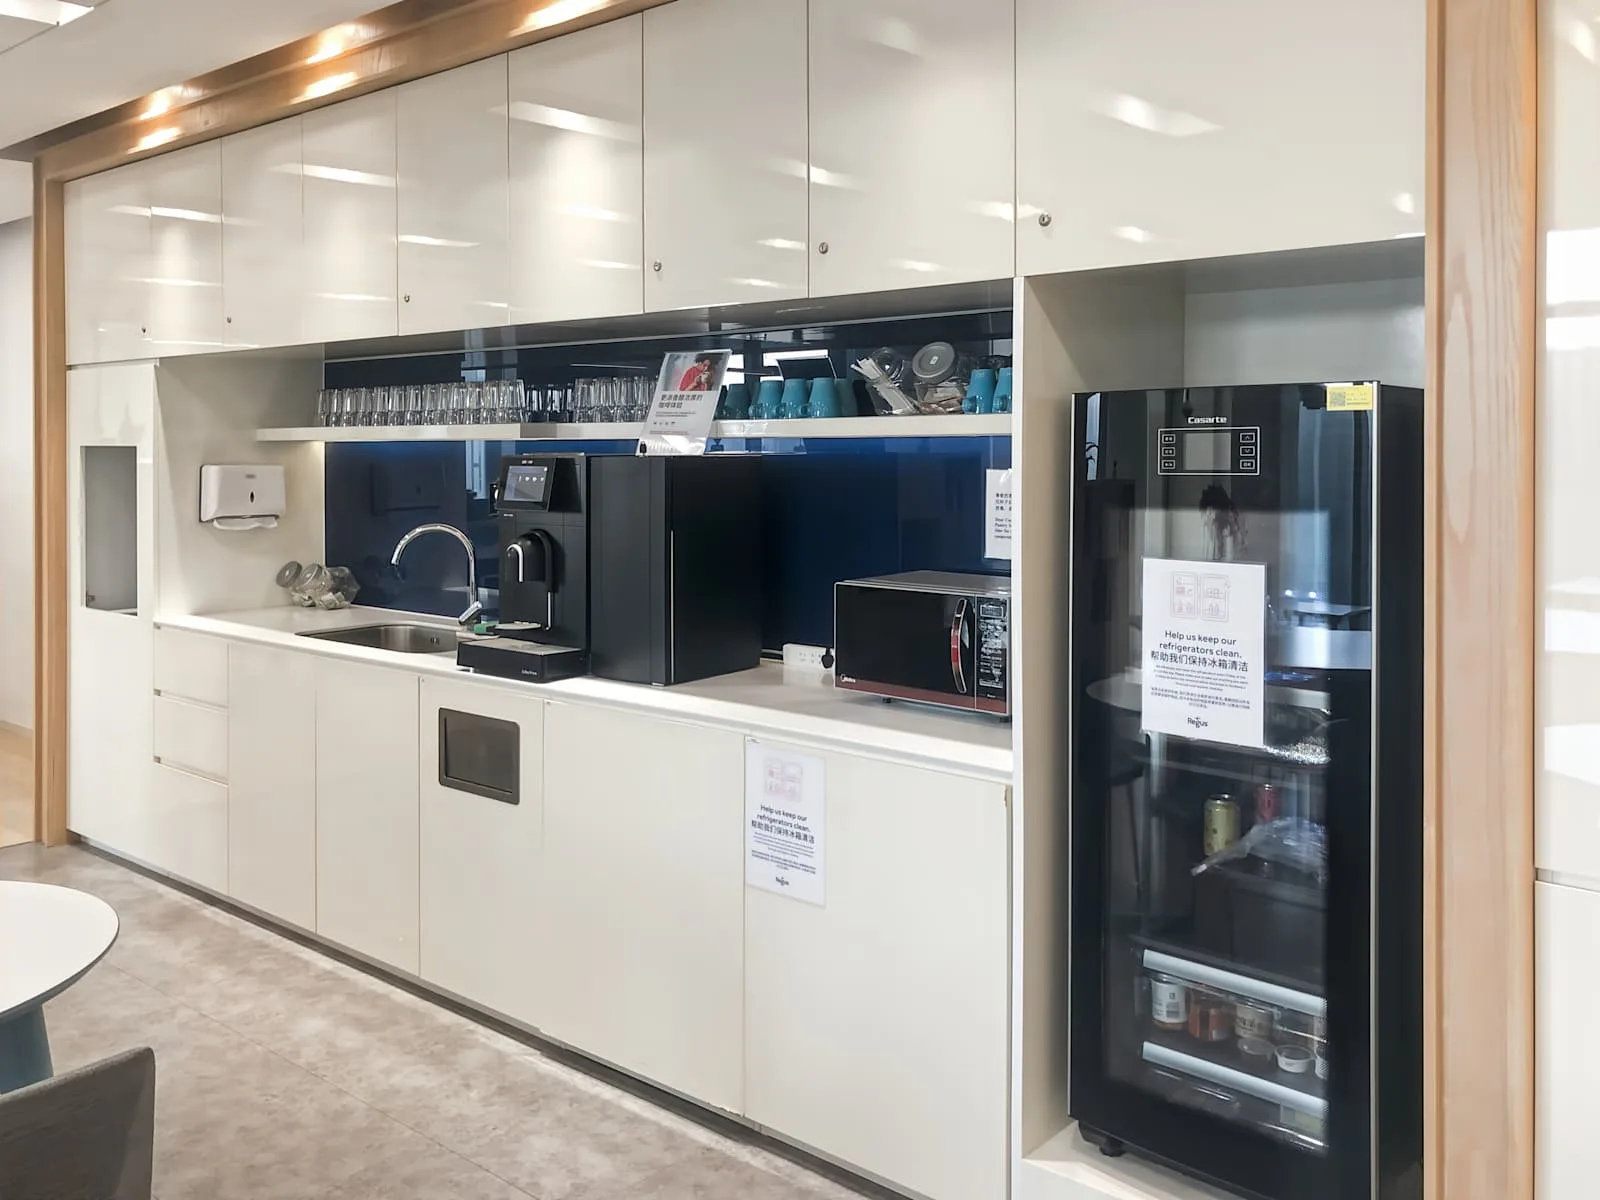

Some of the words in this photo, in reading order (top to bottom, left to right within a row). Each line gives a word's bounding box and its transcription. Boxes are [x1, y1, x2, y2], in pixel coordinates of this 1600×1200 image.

[1188, 416, 1227, 424] Casarte
[1165, 631, 1184, 640] Help
[1197, 635, 1219, 645] keep
[1220, 637, 1237, 645] our
[1159, 642, 1214, 655] refrigerators
[1215, 649, 1242, 659] clean.
[1150, 650, 1248, 672] 帮助我们保持冰箱清洁
[1187, 716, 1208, 728] Regus
[761, 805, 774, 814] Help
[783, 811, 796, 819] keep
[756, 814, 793, 828] refrigerators
[793, 823, 811, 832] clean.
